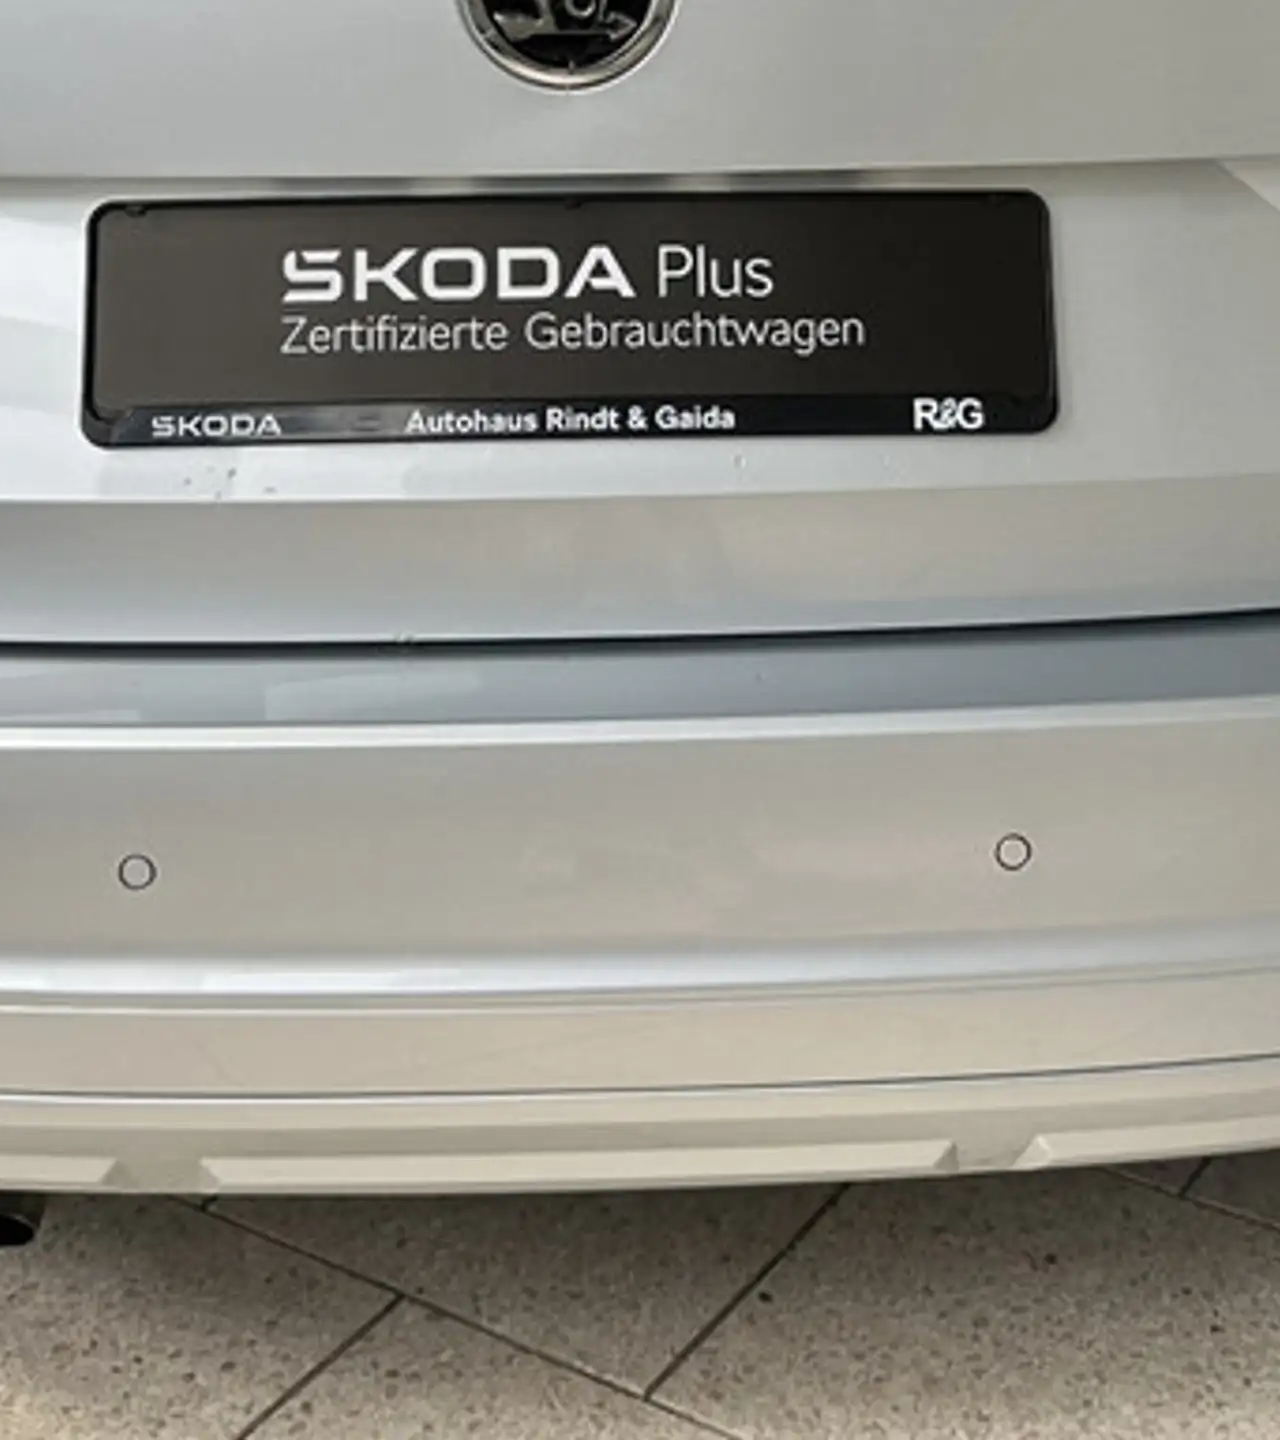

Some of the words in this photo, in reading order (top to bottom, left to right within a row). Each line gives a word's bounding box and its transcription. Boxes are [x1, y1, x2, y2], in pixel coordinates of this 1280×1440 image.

[658, 244, 774, 298] Plus
[280, 312, 509, 355] Zertifizierte
[524, 310, 866, 357] Gebrauchtwagen
[404, 408, 538, 434] Autohaus
[545, 406, 619, 432] Rindt
[627, 407, 648, 430] &
[655, 404, 736, 430] Gaida
[913, 397, 984, 431] R&G
